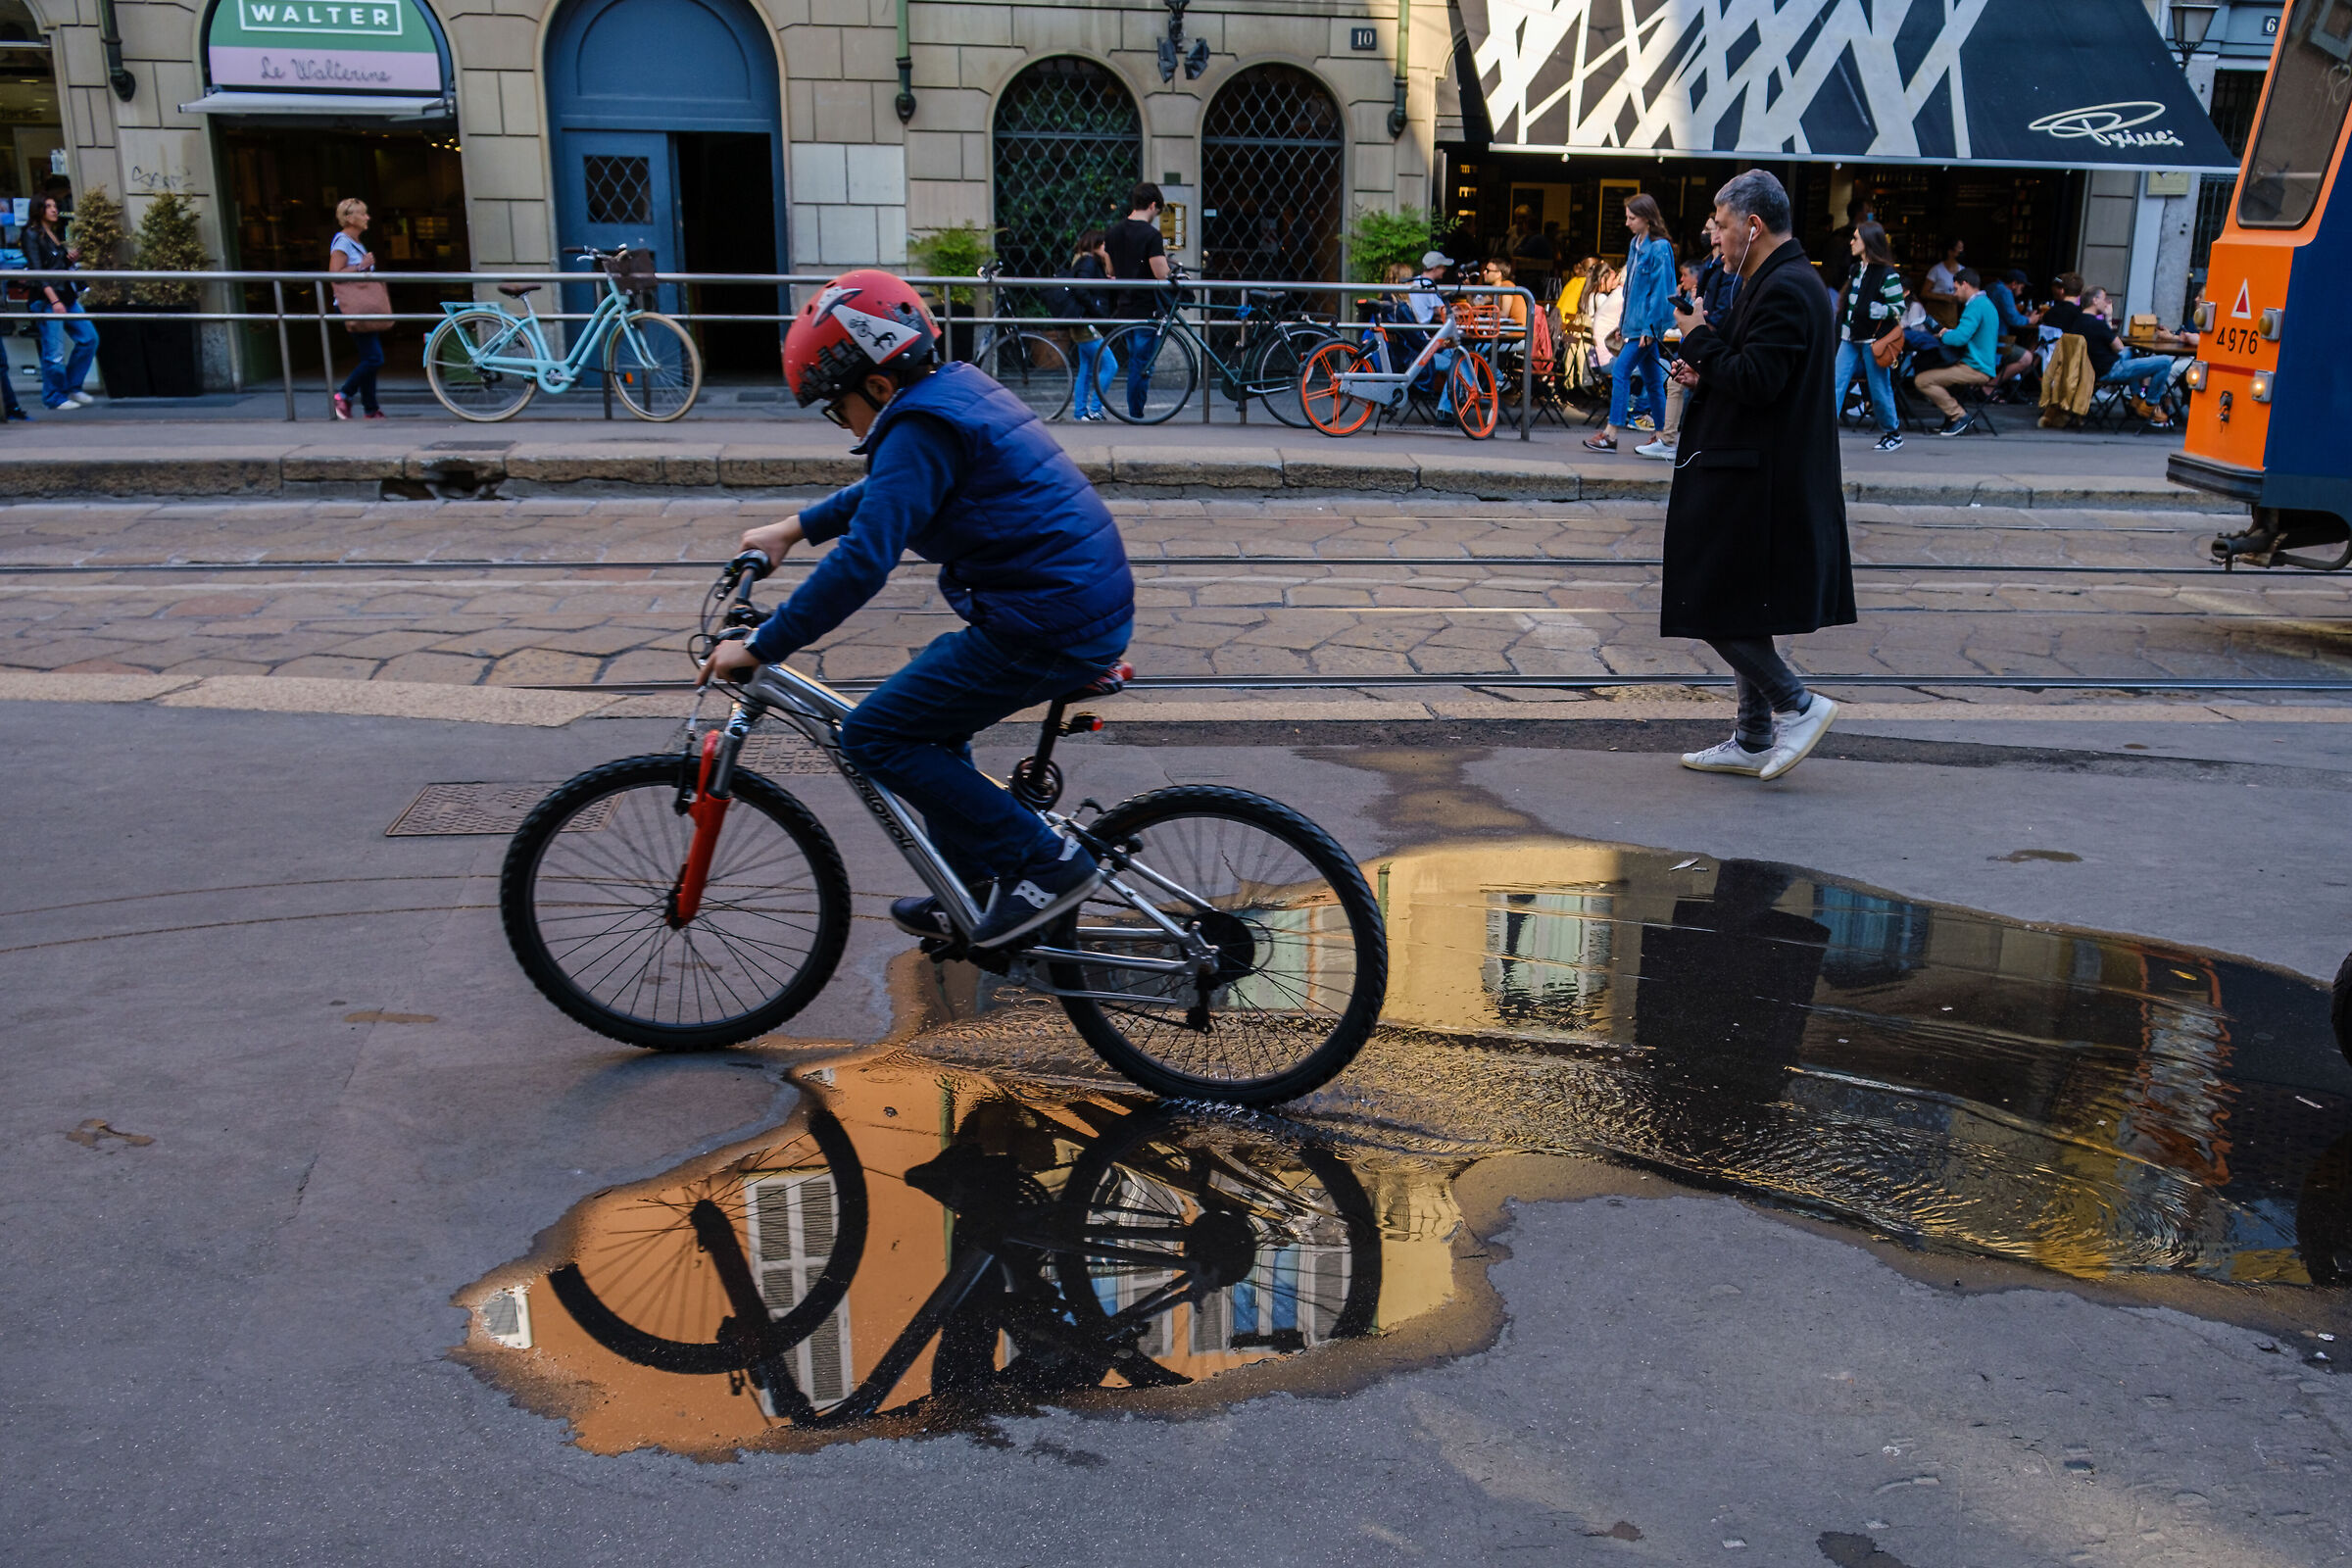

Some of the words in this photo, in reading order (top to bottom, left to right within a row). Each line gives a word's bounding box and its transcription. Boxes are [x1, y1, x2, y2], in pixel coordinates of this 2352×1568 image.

[251, 4, 390, 26] WALTER
[2266, 17, 2277, 32] 6
[1356, 30, 1373, 46] 10
[261, 56, 285, 79] Le
[2217, 326, 2259, 355] 4976
